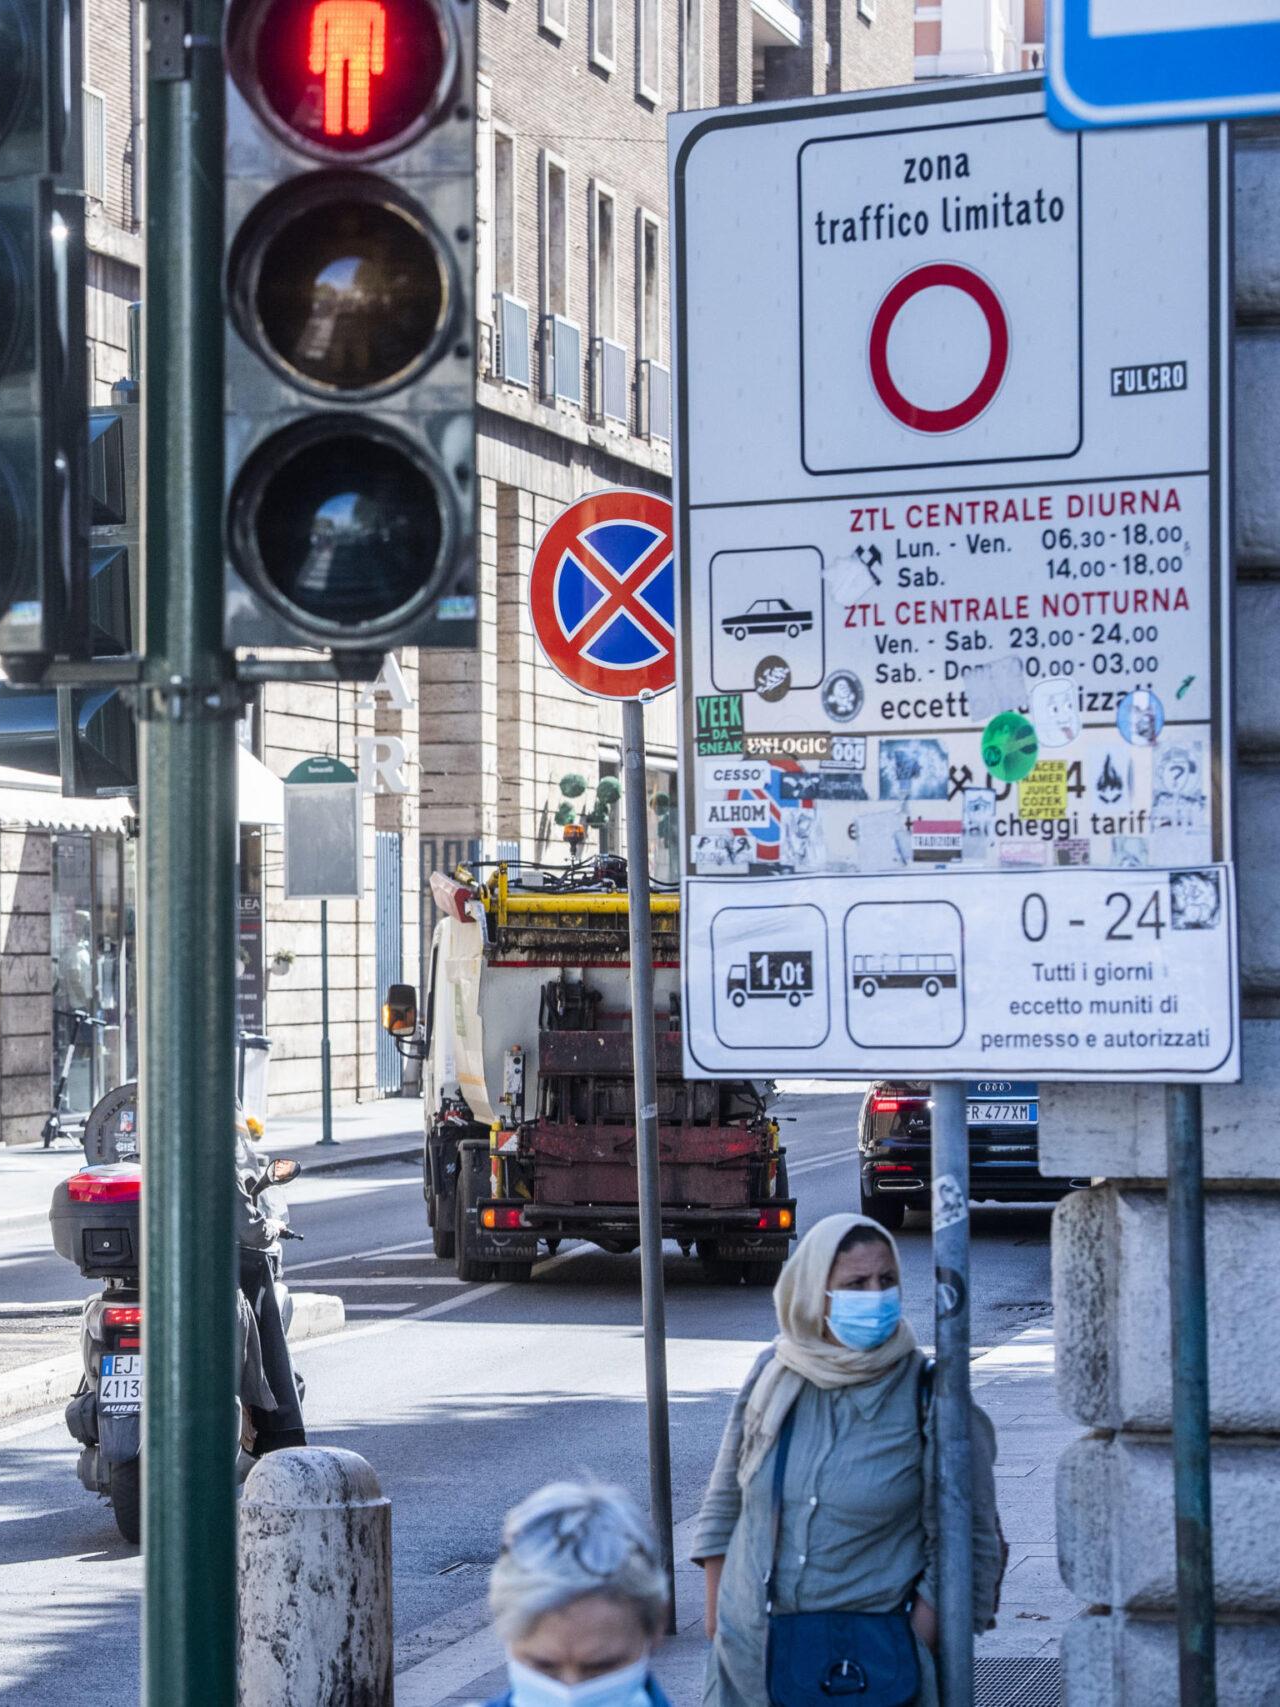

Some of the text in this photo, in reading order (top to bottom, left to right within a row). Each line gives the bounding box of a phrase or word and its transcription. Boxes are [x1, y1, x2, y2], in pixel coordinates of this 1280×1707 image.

[904, 152, 971, 184] zona
[815, 189, 1065, 245] traffico limitato
[1112, 363, 1184, 394] FULCRO
[849, 487, 1182, 533] ZTL CENTRALE DIURNA
[895, 537, 941, 559] Lun.
[966, 533, 1012, 555] Ven.
[897, 567, 945, 588] Sab.
[844, 587, 1190, 628] ZTL CENTRALE NOTTURNA
[874, 633, 920, 655] Ven.
[945, 630, 994, 652] Sab.
[875, 662, 922, 685] Sab.
[698, 695, 742, 729] YEEK
[880, 691, 970, 720] eccett
[712, 730, 729, 740] DA
[699, 741, 742, 755] SNEAK
[713, 769, 761, 781] CESSO
[1031, 761, 1065, 772] ACER
[1025, 785, 1060, 795] JUICE
[708, 805, 765, 822] ALHOM
[913, 836, 961, 847] TRADIZIONE
[1022, 892, 1049, 942] 0
[1104, 890, 1166, 942] 24
[1032, 961, 1153, 988] Tutti i giorni
[1009, 994, 1178, 1017] eccetto muniti di
[981, 1028, 1210, 1051] permesso e autorizzati
